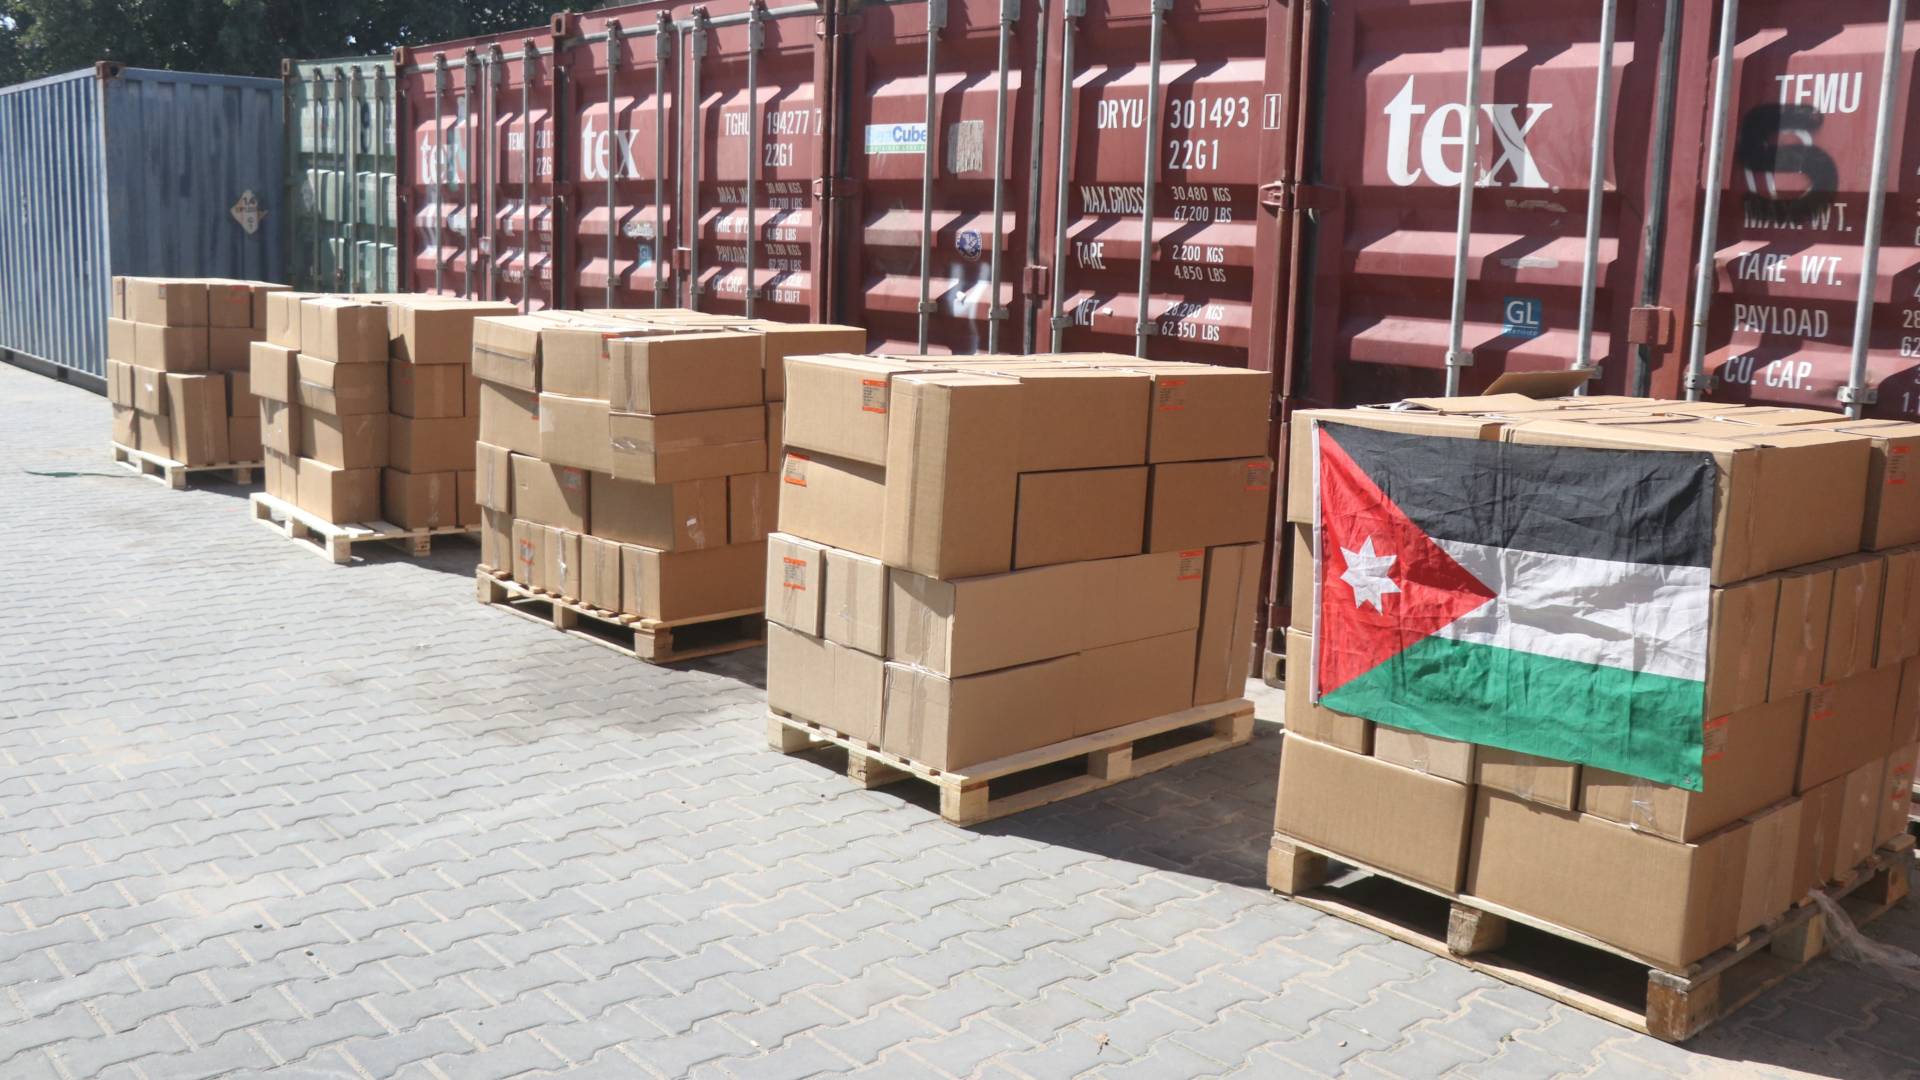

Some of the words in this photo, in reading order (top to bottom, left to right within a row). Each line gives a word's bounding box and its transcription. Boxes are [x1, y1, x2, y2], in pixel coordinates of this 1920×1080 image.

[767, 110, 810, 135] 194277
[1097, 98, 1144, 129] DRYU
[1170, 96, 1250, 129] 301493
[1384, 74, 1552, 188] tex
[582, 115, 641, 180] tex
[764, 143, 793, 167] 22G1
[1168, 139, 1219, 170] 22G1
[1171, 186, 1208, 202] 30.480
[1212, 187, 1232, 202] KGS
[1173, 205, 1209, 222] 67.200
[1214, 207, 1232, 223] LBS
[1076, 242, 1106, 270] TARE
[1172, 245, 1200, 262] 2.200
[1206, 246, 1224, 263] KGS
[1738, 252, 1788, 283] TARE
[1800, 256, 1843, 286] WT.
[1174, 265, 1203, 281] 4.850
[1209, 267, 1227, 283] LBS
[1075, 299, 1099, 326] NET
[1165, 302, 1201, 318] 28.280
[1205, 304, 1225, 320] KGS
[1506, 300, 1539, 324] GL
[1734, 304, 1829, 338] PAYLOAD
[1162, 322, 1197, 338] 62.350
[1202, 324, 1220, 341] LBS
[1724, 355, 1757, 386] CU.
[1766, 360, 1812, 391] CAP.
